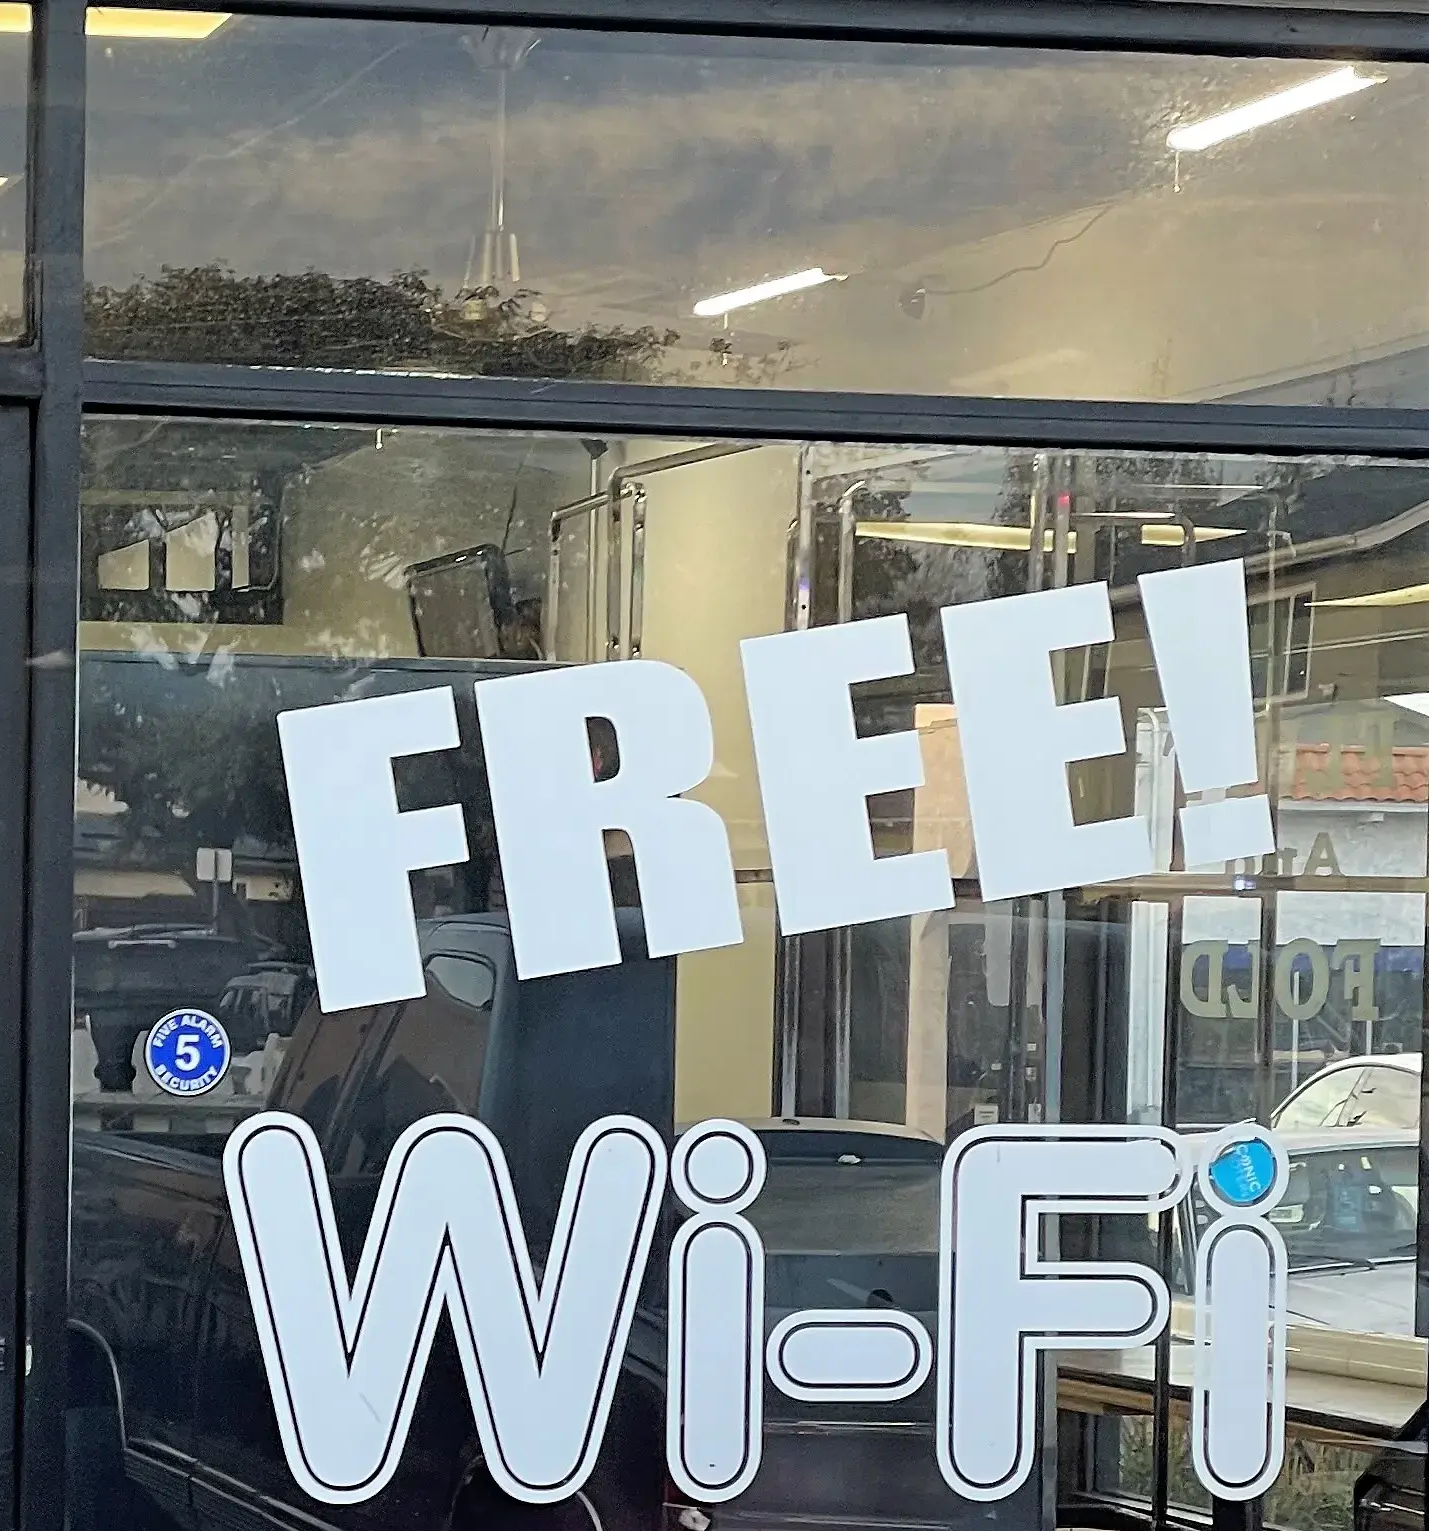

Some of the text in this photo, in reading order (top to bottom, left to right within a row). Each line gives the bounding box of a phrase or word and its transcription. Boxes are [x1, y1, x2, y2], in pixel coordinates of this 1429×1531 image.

[277, 557, 1276, 1014] FREE!
[152, 1014, 223, 1049] FIVE ALARM
[174, 1034, 201, 1071] 5
[154, 1064, 218, 1091] SECURITY
[223, 1111, 1288, 1505] Wi-Fi
